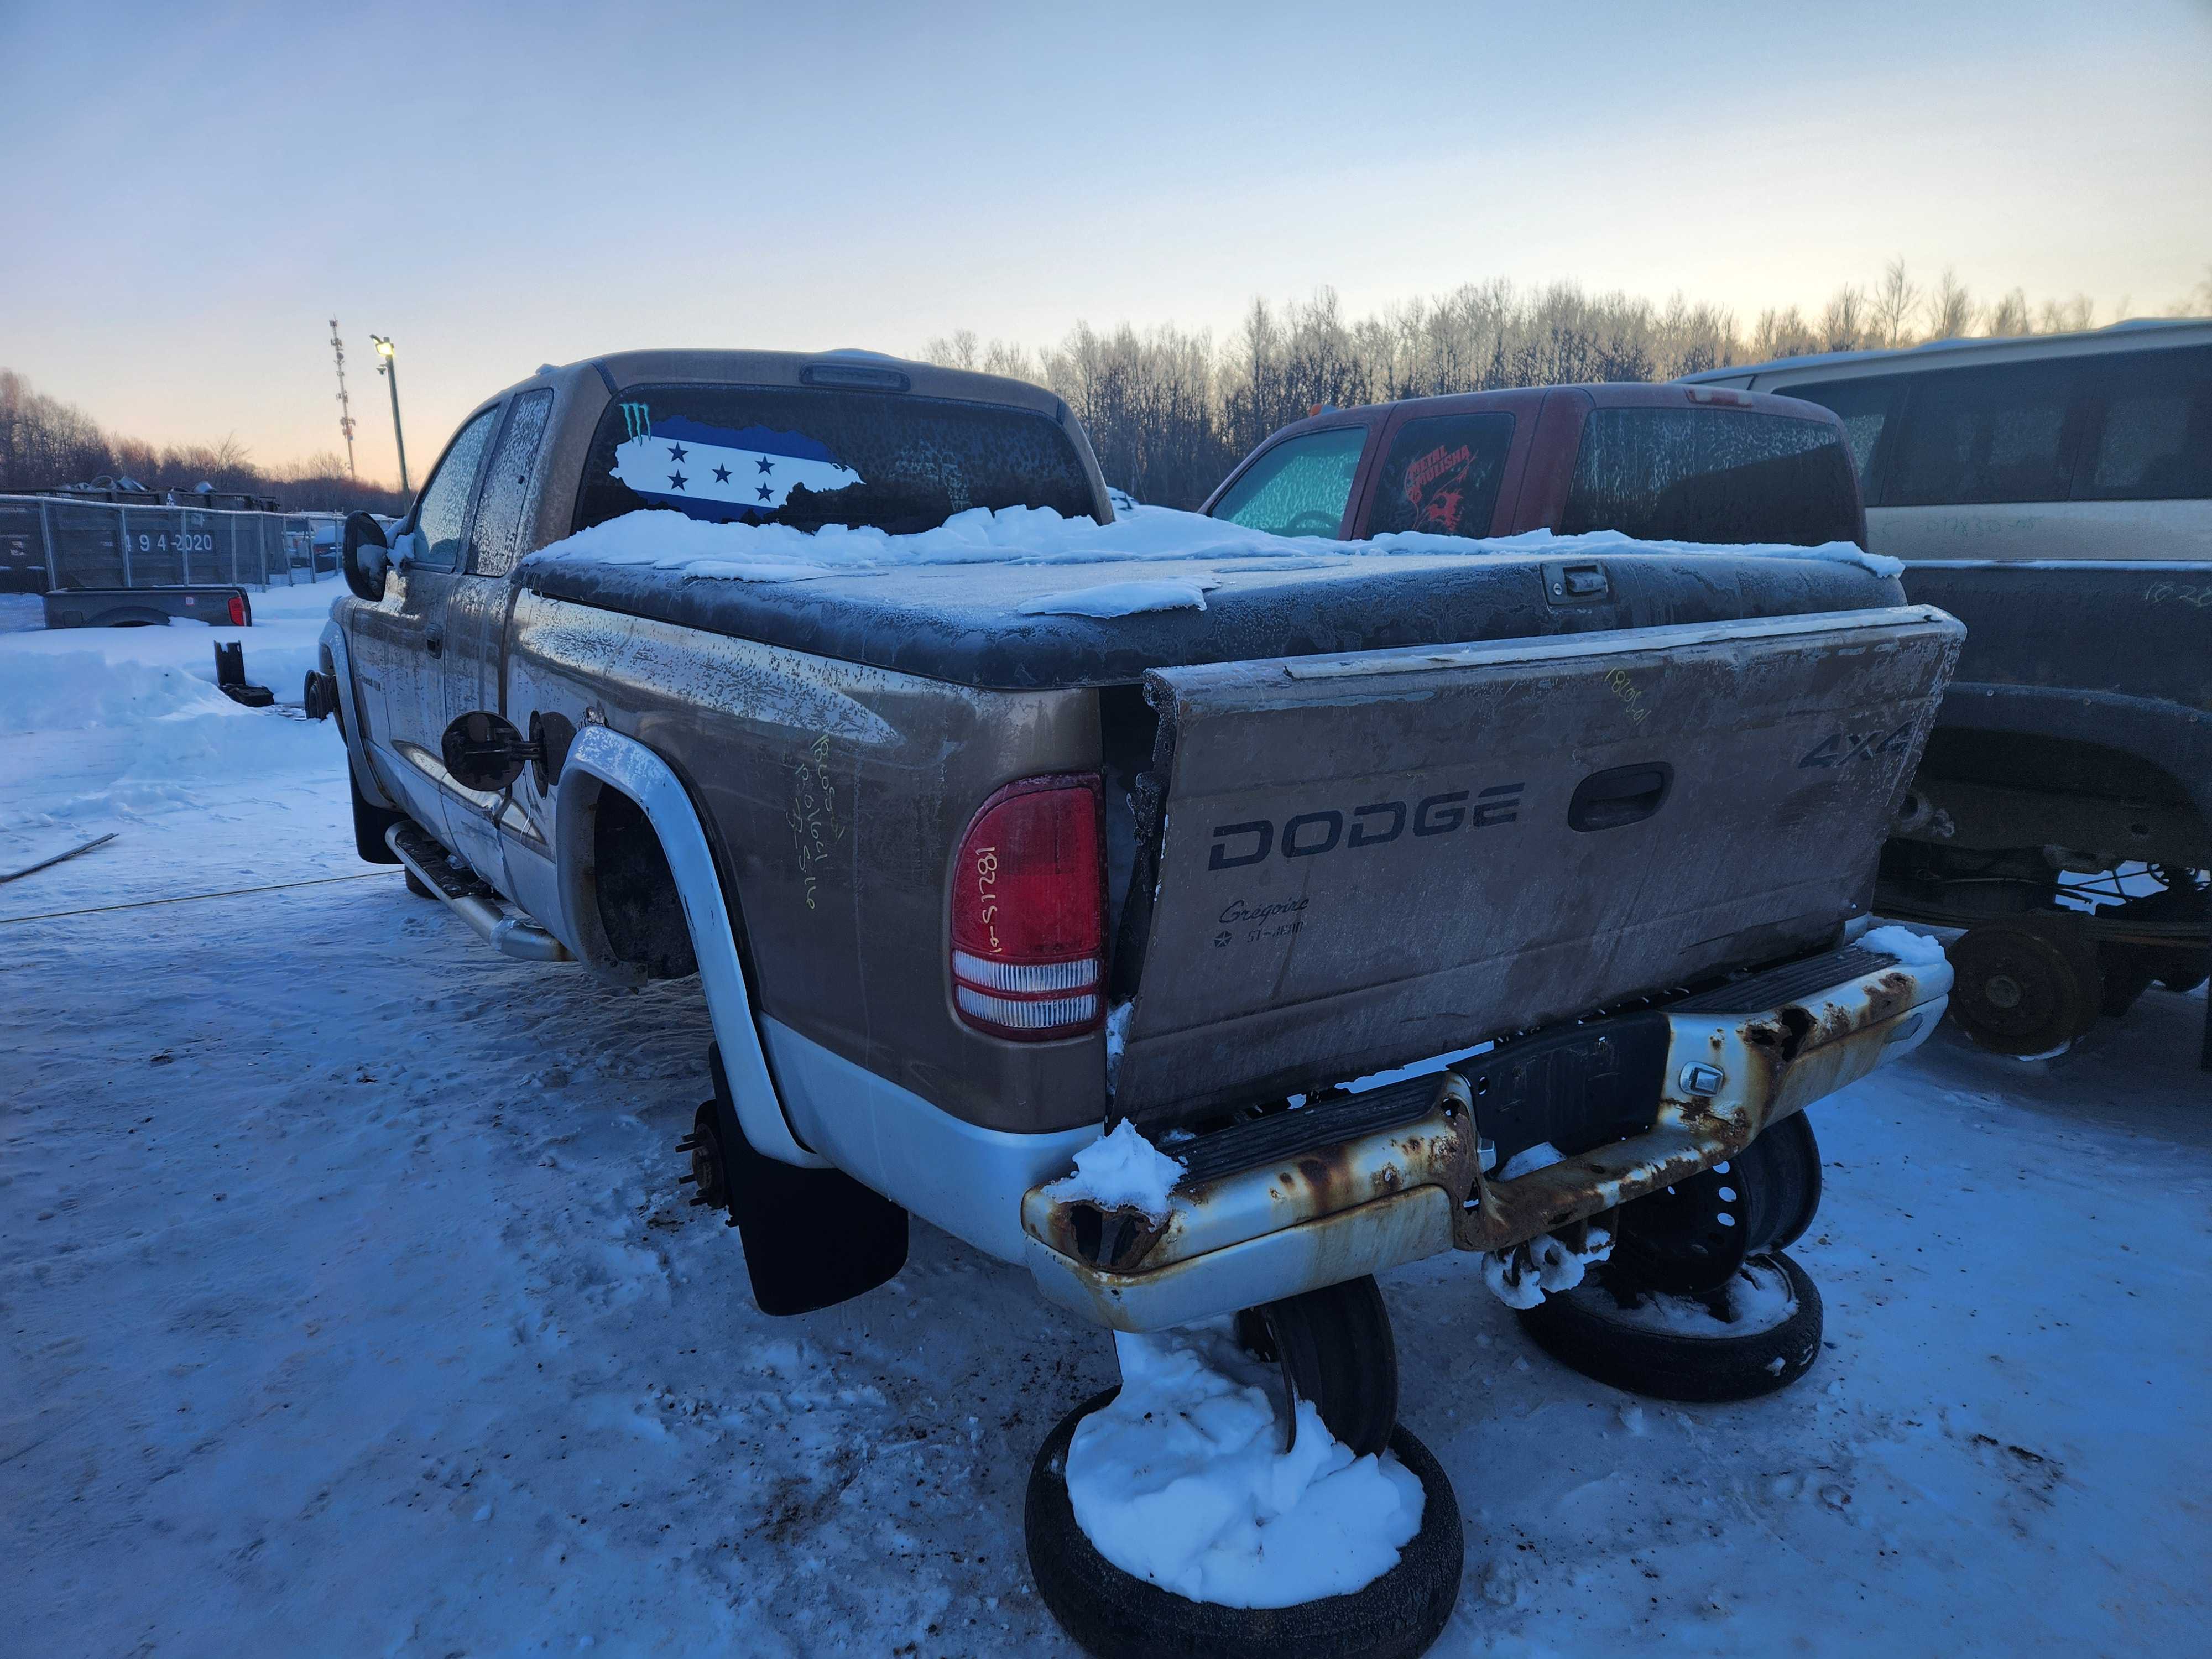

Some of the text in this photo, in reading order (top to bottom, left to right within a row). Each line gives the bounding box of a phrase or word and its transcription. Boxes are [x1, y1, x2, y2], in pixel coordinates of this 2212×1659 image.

[1408, 445, 1447, 480] METAL
[1415, 445, 1470, 486] MULISHA
[1208, 782, 1526, 872] DODGE
[1218, 896, 1310, 926] Grégoire
